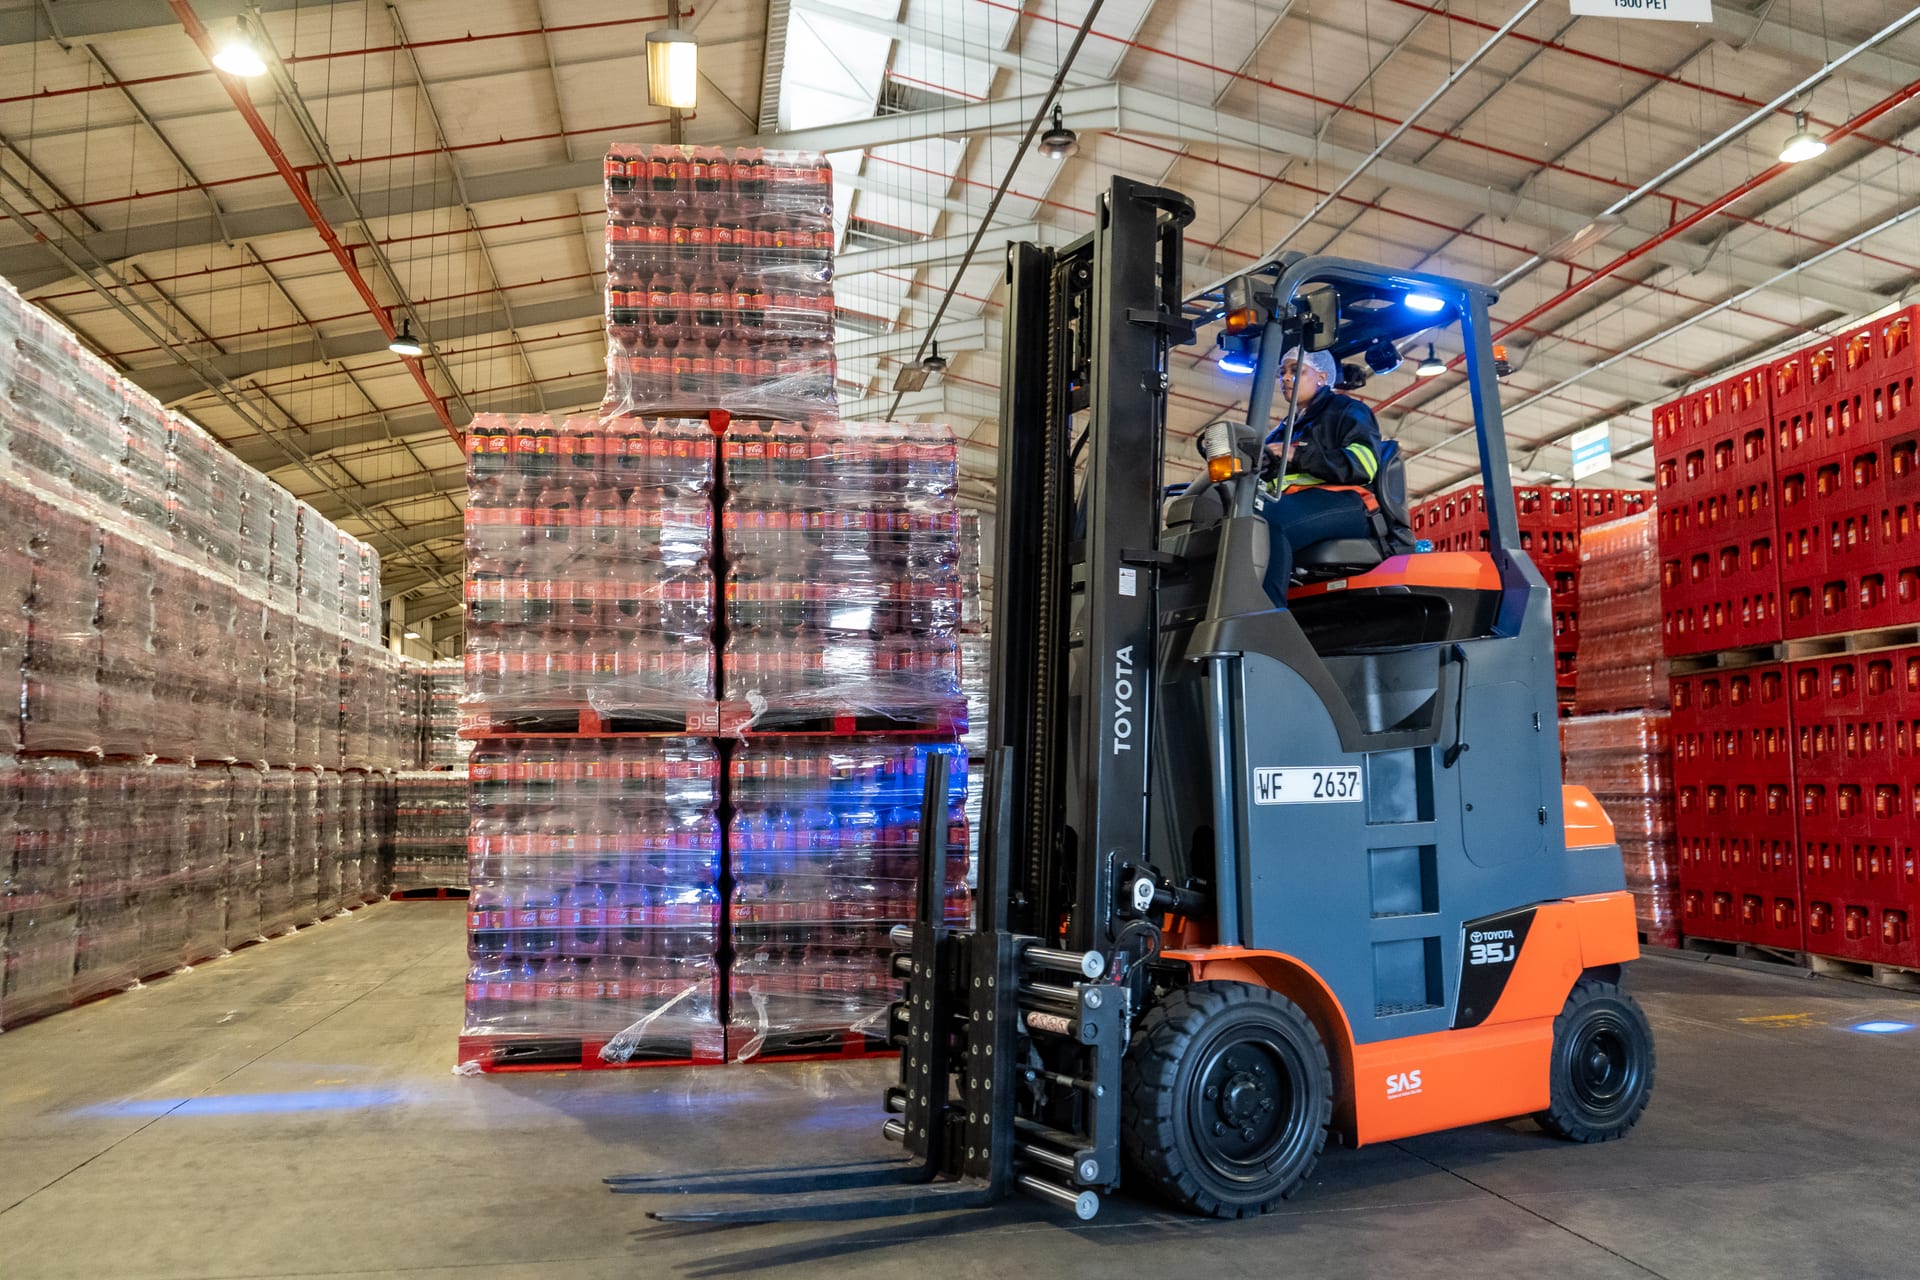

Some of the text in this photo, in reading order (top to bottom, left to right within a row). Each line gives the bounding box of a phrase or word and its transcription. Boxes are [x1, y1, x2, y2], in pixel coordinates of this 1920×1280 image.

[1114, 645, 1134, 755] TOYOTA
[1259, 772, 1358, 800] WF 2637
[1482, 930, 1515, 941] TOYOTA
[1470, 943, 1515, 965] 35J
[1386, 1070, 1421, 1094] SAS
